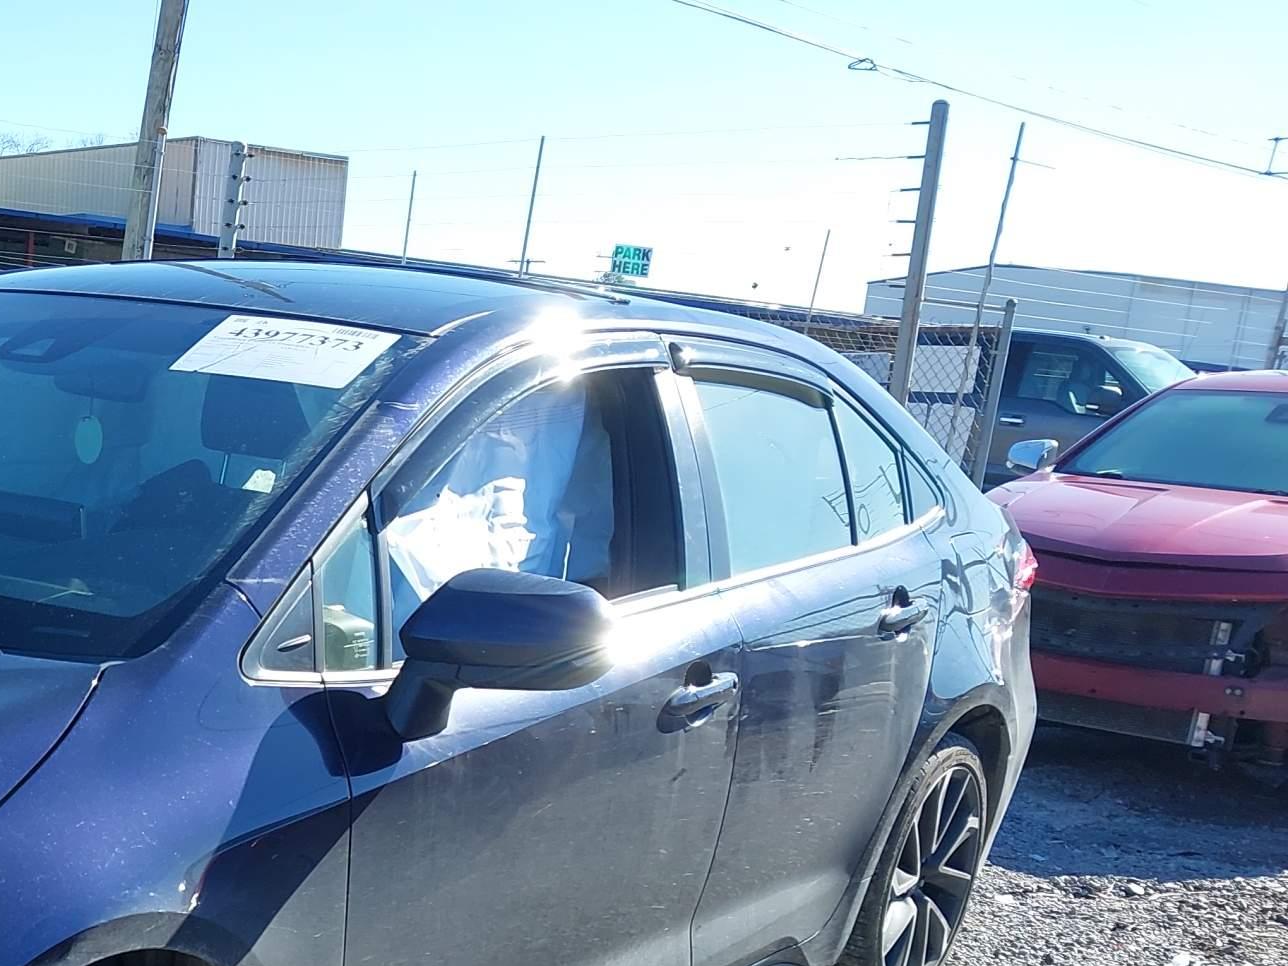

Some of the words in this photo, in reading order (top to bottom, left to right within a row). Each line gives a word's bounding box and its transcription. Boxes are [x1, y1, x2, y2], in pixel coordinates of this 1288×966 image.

[614, 246, 653, 262] PARK
[611, 260, 650, 276] HERE
[228, 327, 364, 352] 43977373
